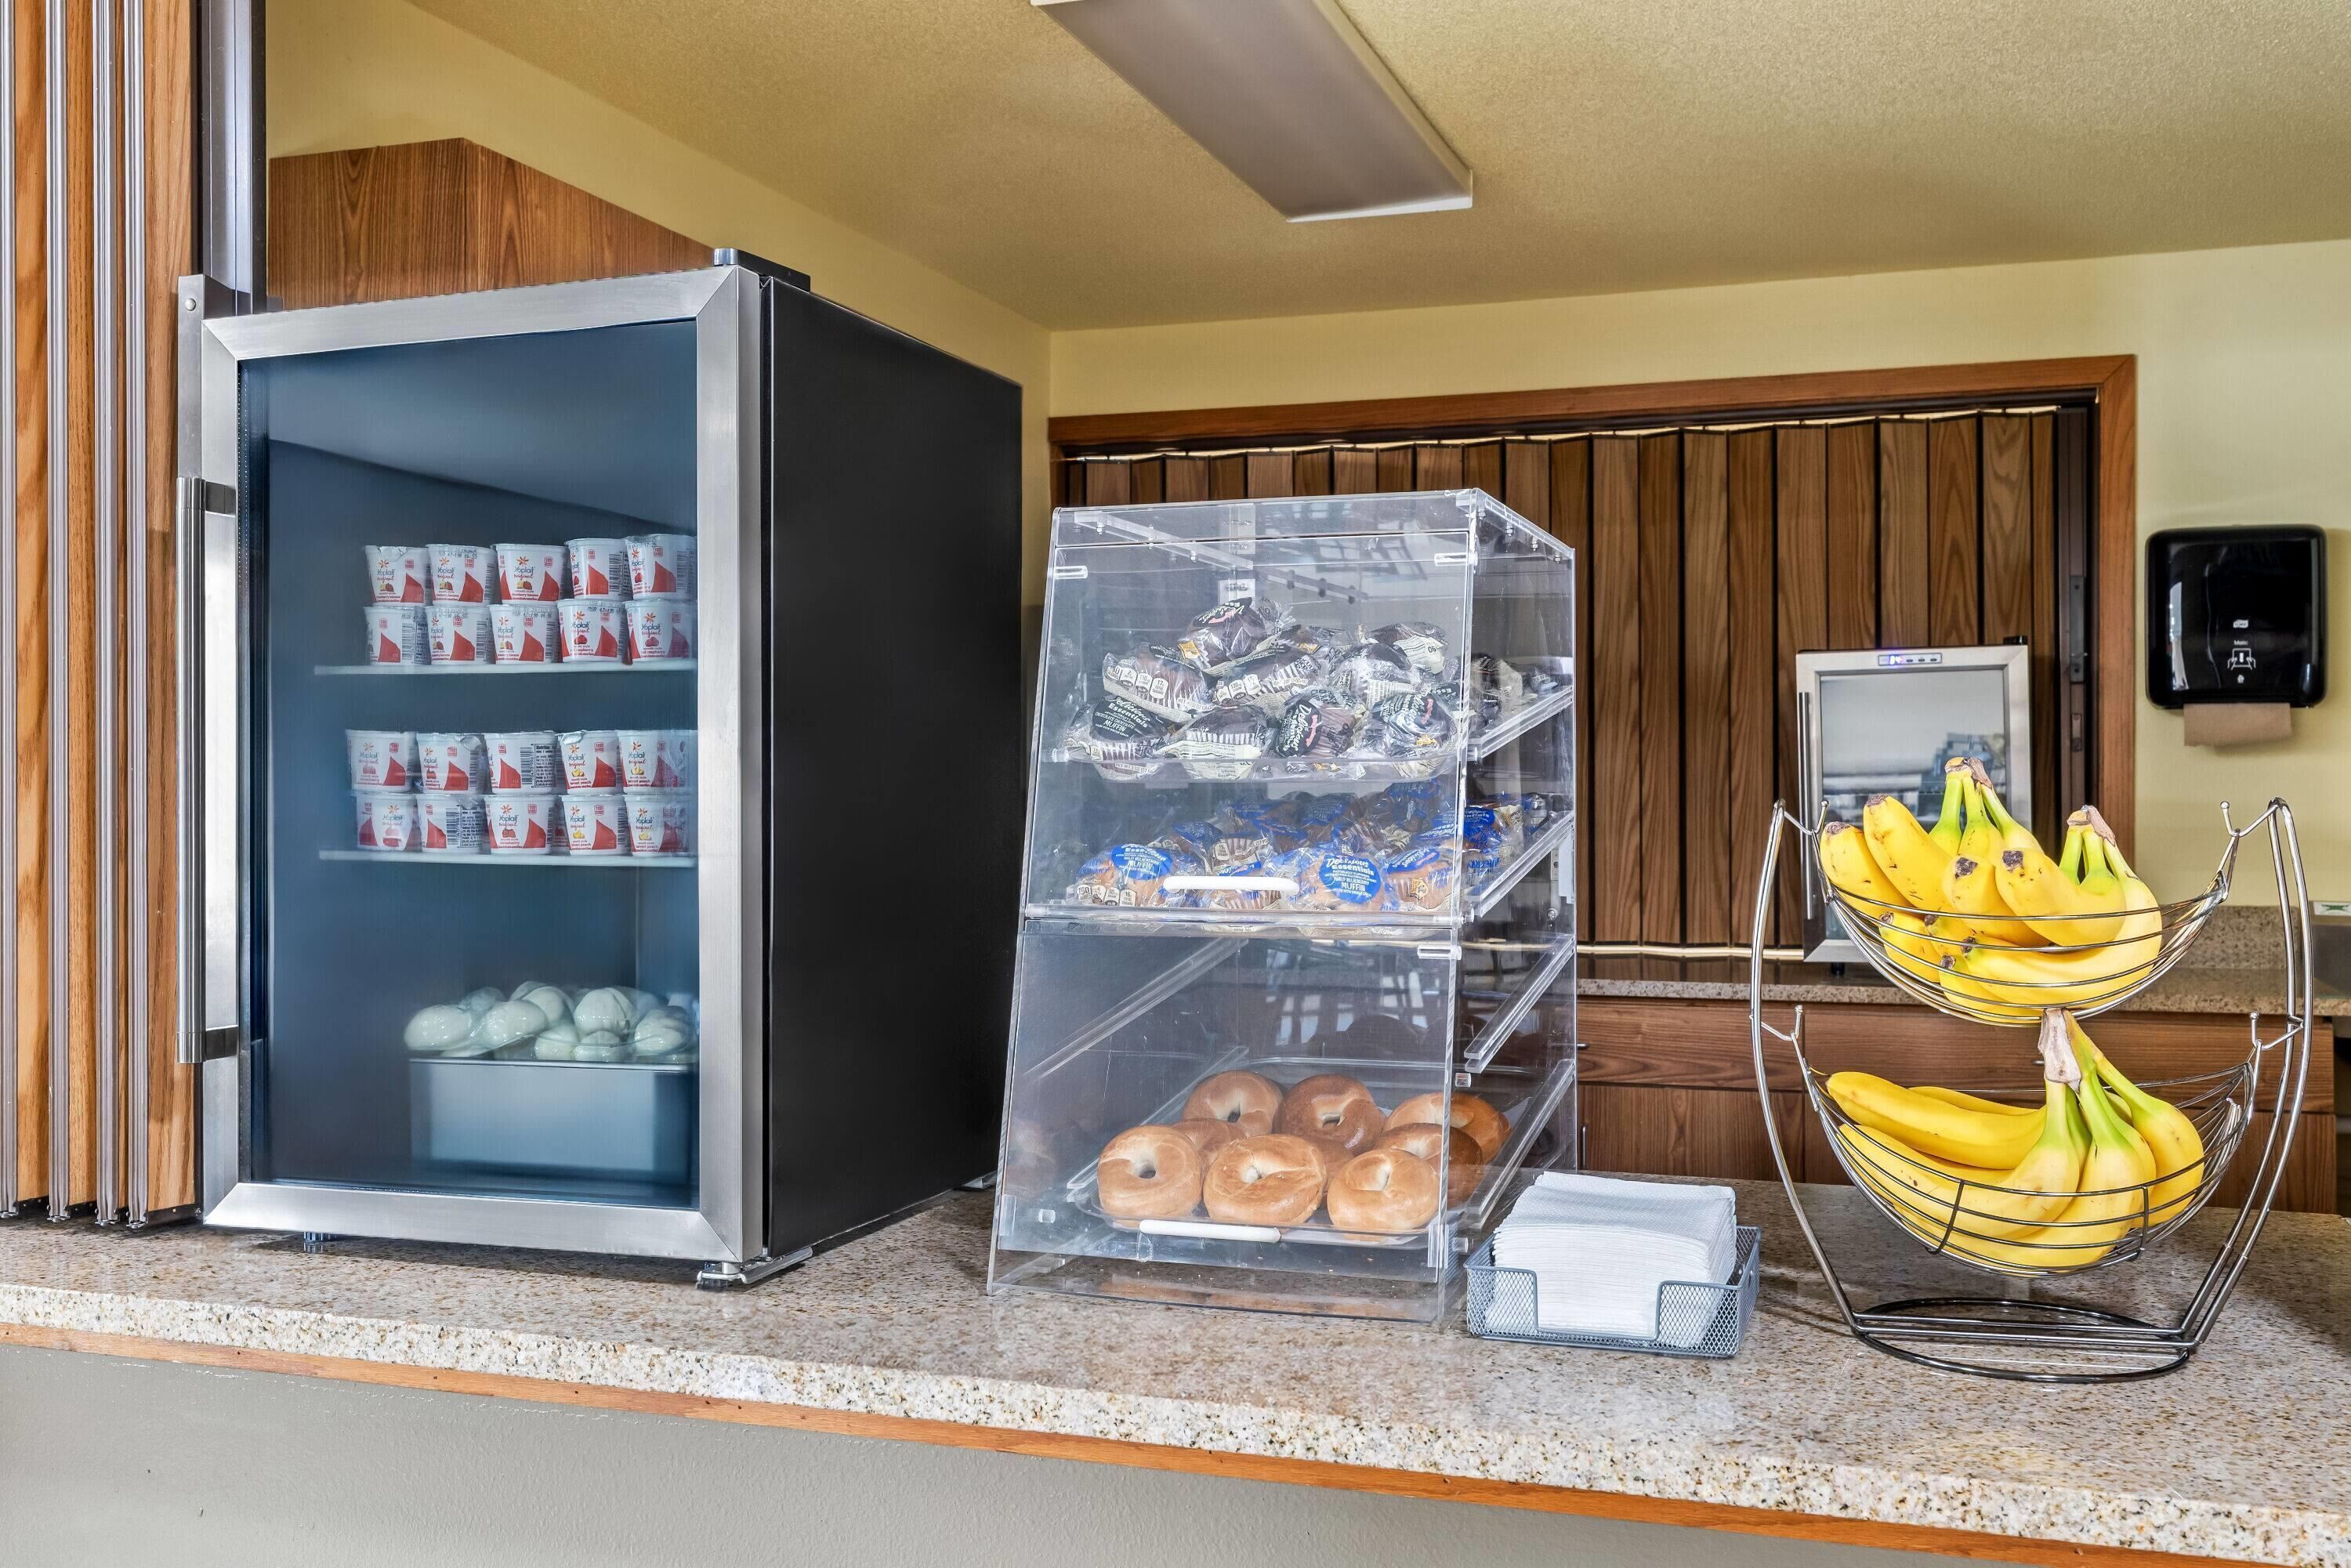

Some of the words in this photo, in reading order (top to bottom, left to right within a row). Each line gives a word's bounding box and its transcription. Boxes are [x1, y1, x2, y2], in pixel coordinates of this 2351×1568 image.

[377, 569, 395, 578] Yoplait
[437, 567, 455, 575] Yoplait
[514, 565, 534, 575] Yoplait
[571, 621, 589, 631] Yoplait
[641, 623, 661, 632] Yoplait
[1108, 703, 1148, 728] Essentials
[1103, 720, 1126, 732] MUFFIN
[1291, 704, 1312, 751] Delicious
[568, 753, 585, 762] Yoplait
[499, 814, 518, 824] Yoplait
[570, 815, 585, 824] Yoplait
[636, 817, 654, 826] Yoplait
[1128, 860, 1153, 870] MUFFIN
[1331, 864, 1375, 876] Essentials
[1341, 882, 1366, 892] MUFFIN
